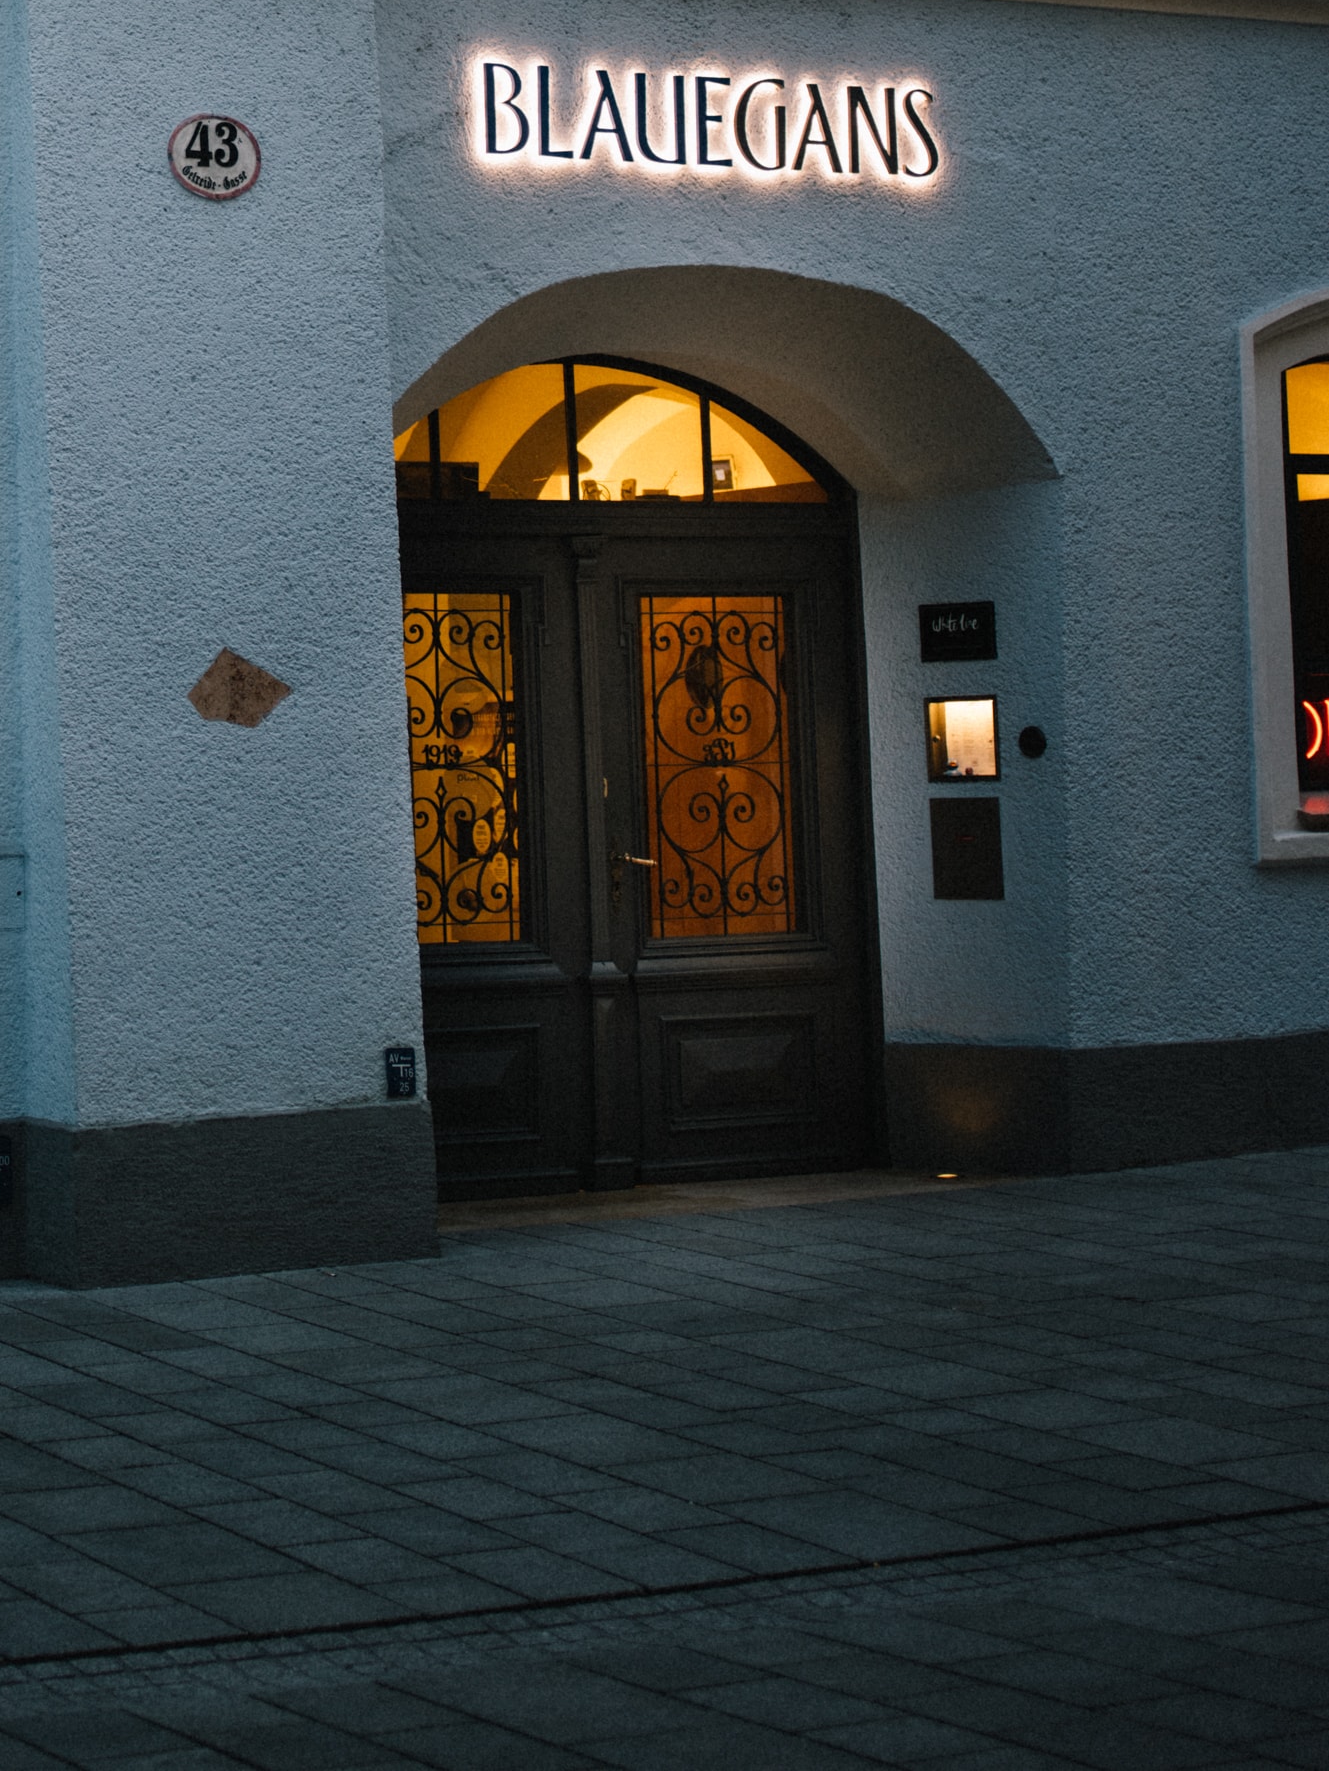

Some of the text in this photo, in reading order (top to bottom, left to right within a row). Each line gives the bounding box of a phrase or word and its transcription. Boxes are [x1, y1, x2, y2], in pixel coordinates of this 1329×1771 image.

[483, 62, 939, 177] BLAUEGANS
[185, 121, 239, 168] 43
[389, 1053, 399, 1063] AV
